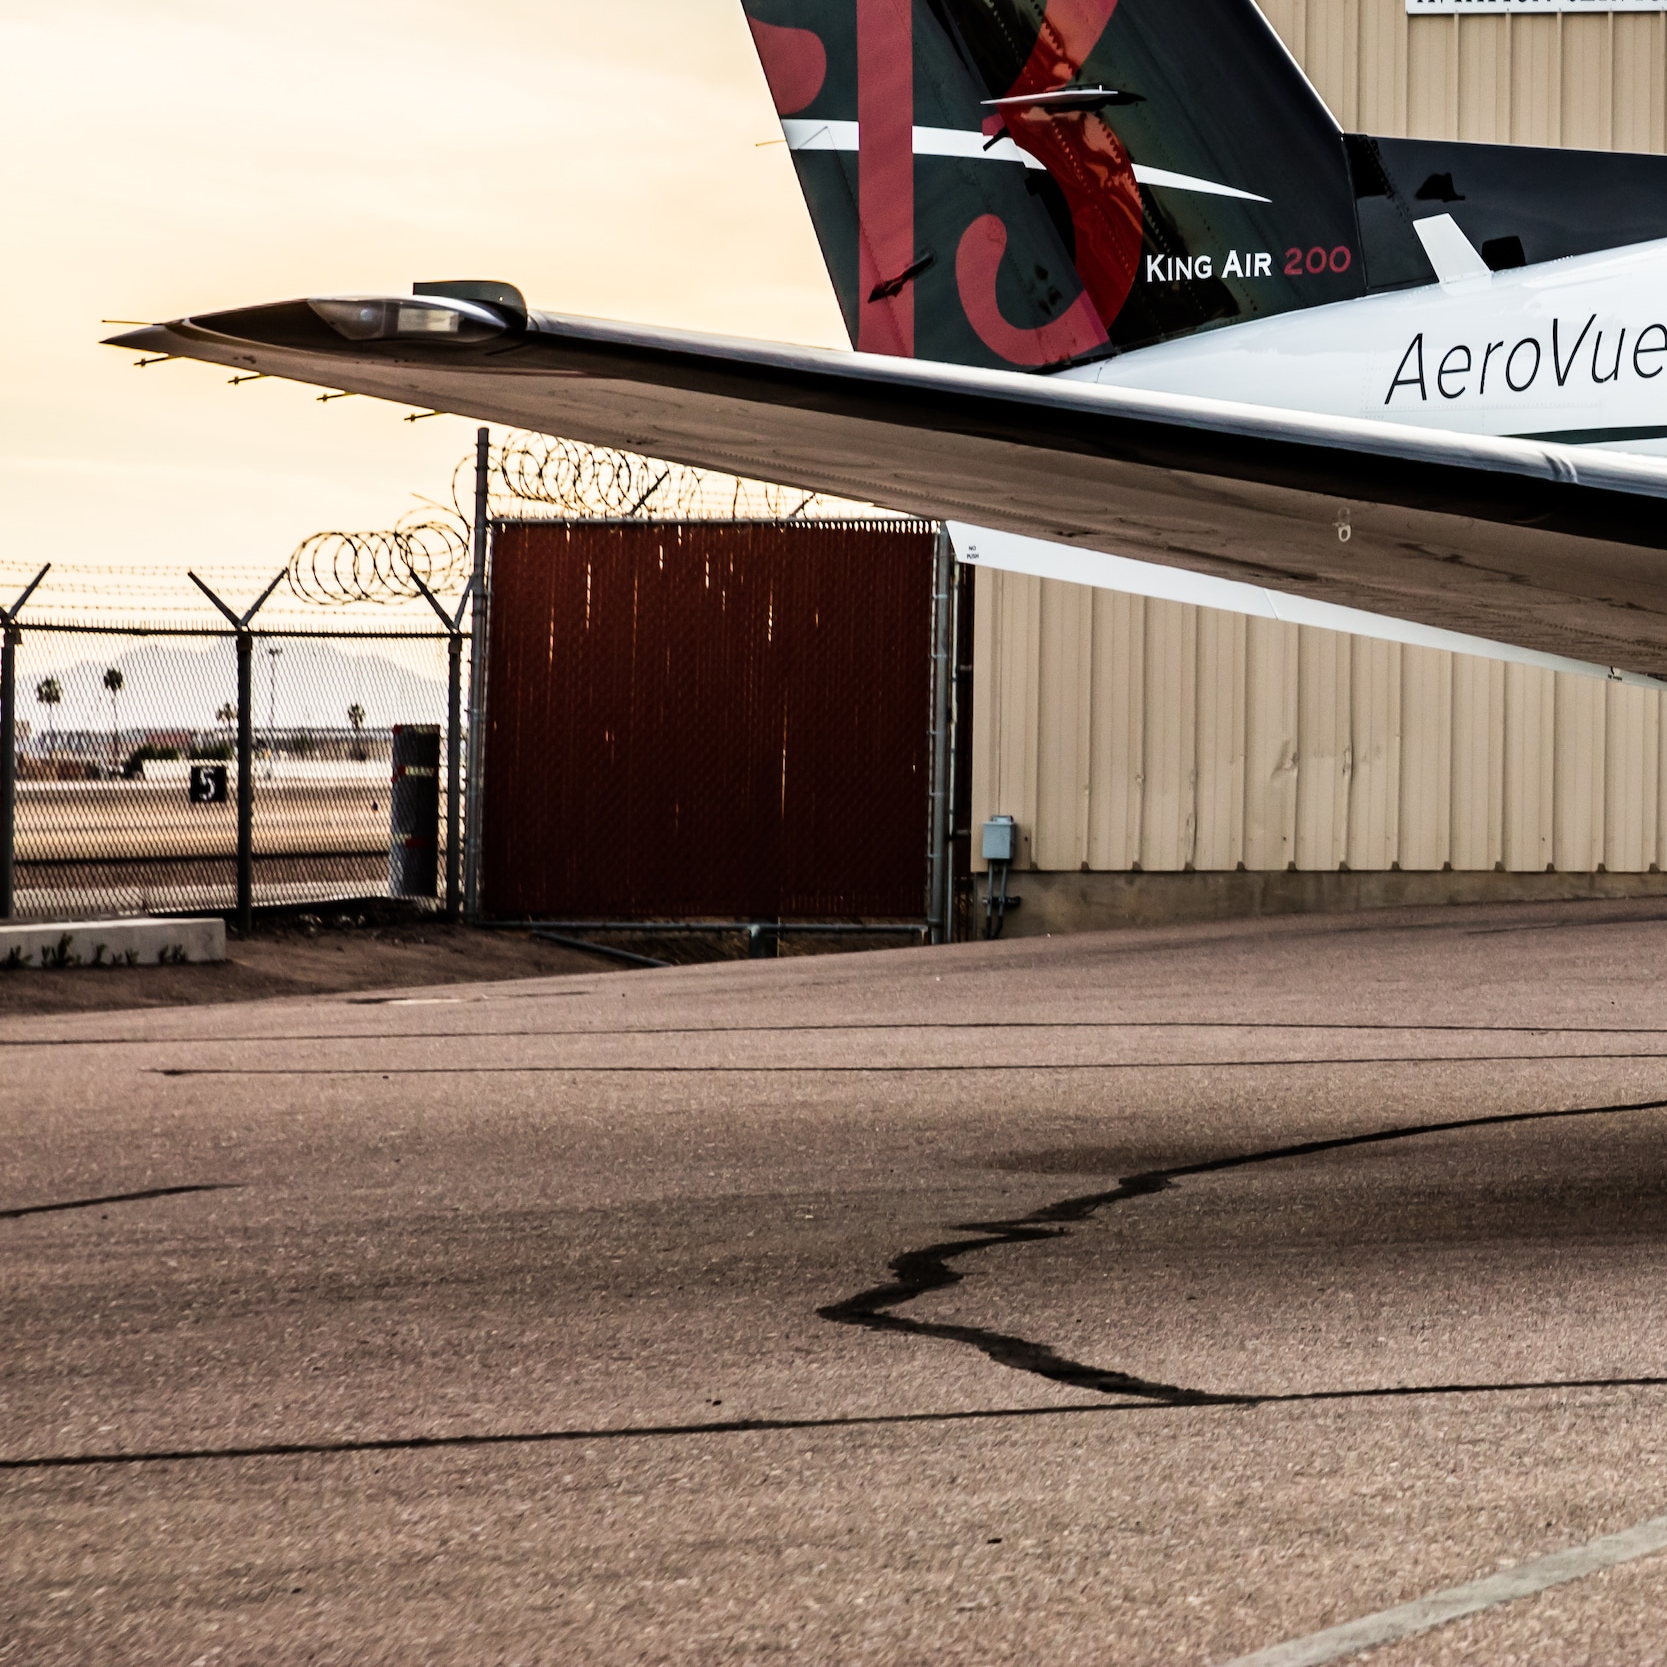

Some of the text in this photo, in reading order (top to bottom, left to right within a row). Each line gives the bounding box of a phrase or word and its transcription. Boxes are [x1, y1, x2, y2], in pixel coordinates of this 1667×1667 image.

[1146, 245, 1352, 283] KING AIR 200
[199, 766, 216, 801] 5
